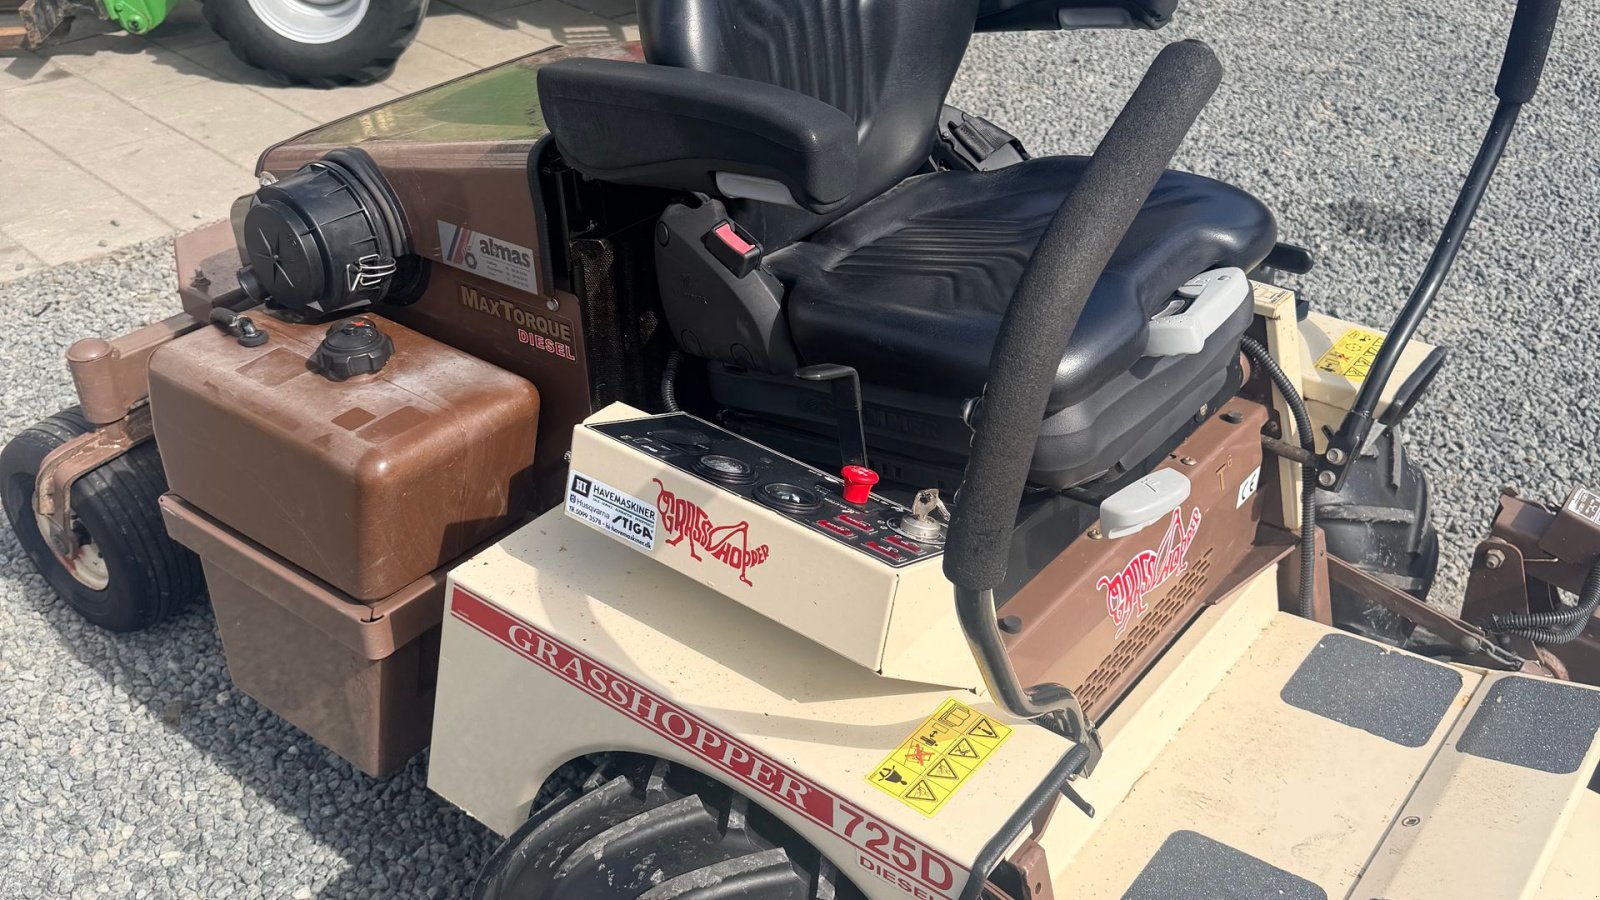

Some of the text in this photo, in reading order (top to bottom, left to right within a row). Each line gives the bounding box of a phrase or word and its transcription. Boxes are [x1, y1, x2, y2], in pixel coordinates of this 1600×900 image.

[517, 329, 576, 361] DIESEL
[576, 499, 610, 519] Husqvarna
[593, 484, 656, 520] HAVEMASKINER
[653, 478, 769, 587] GRASSHOPPER
[508, 624, 809, 810] GRASSHOPPER
[839, 803, 953, 891] 725D
